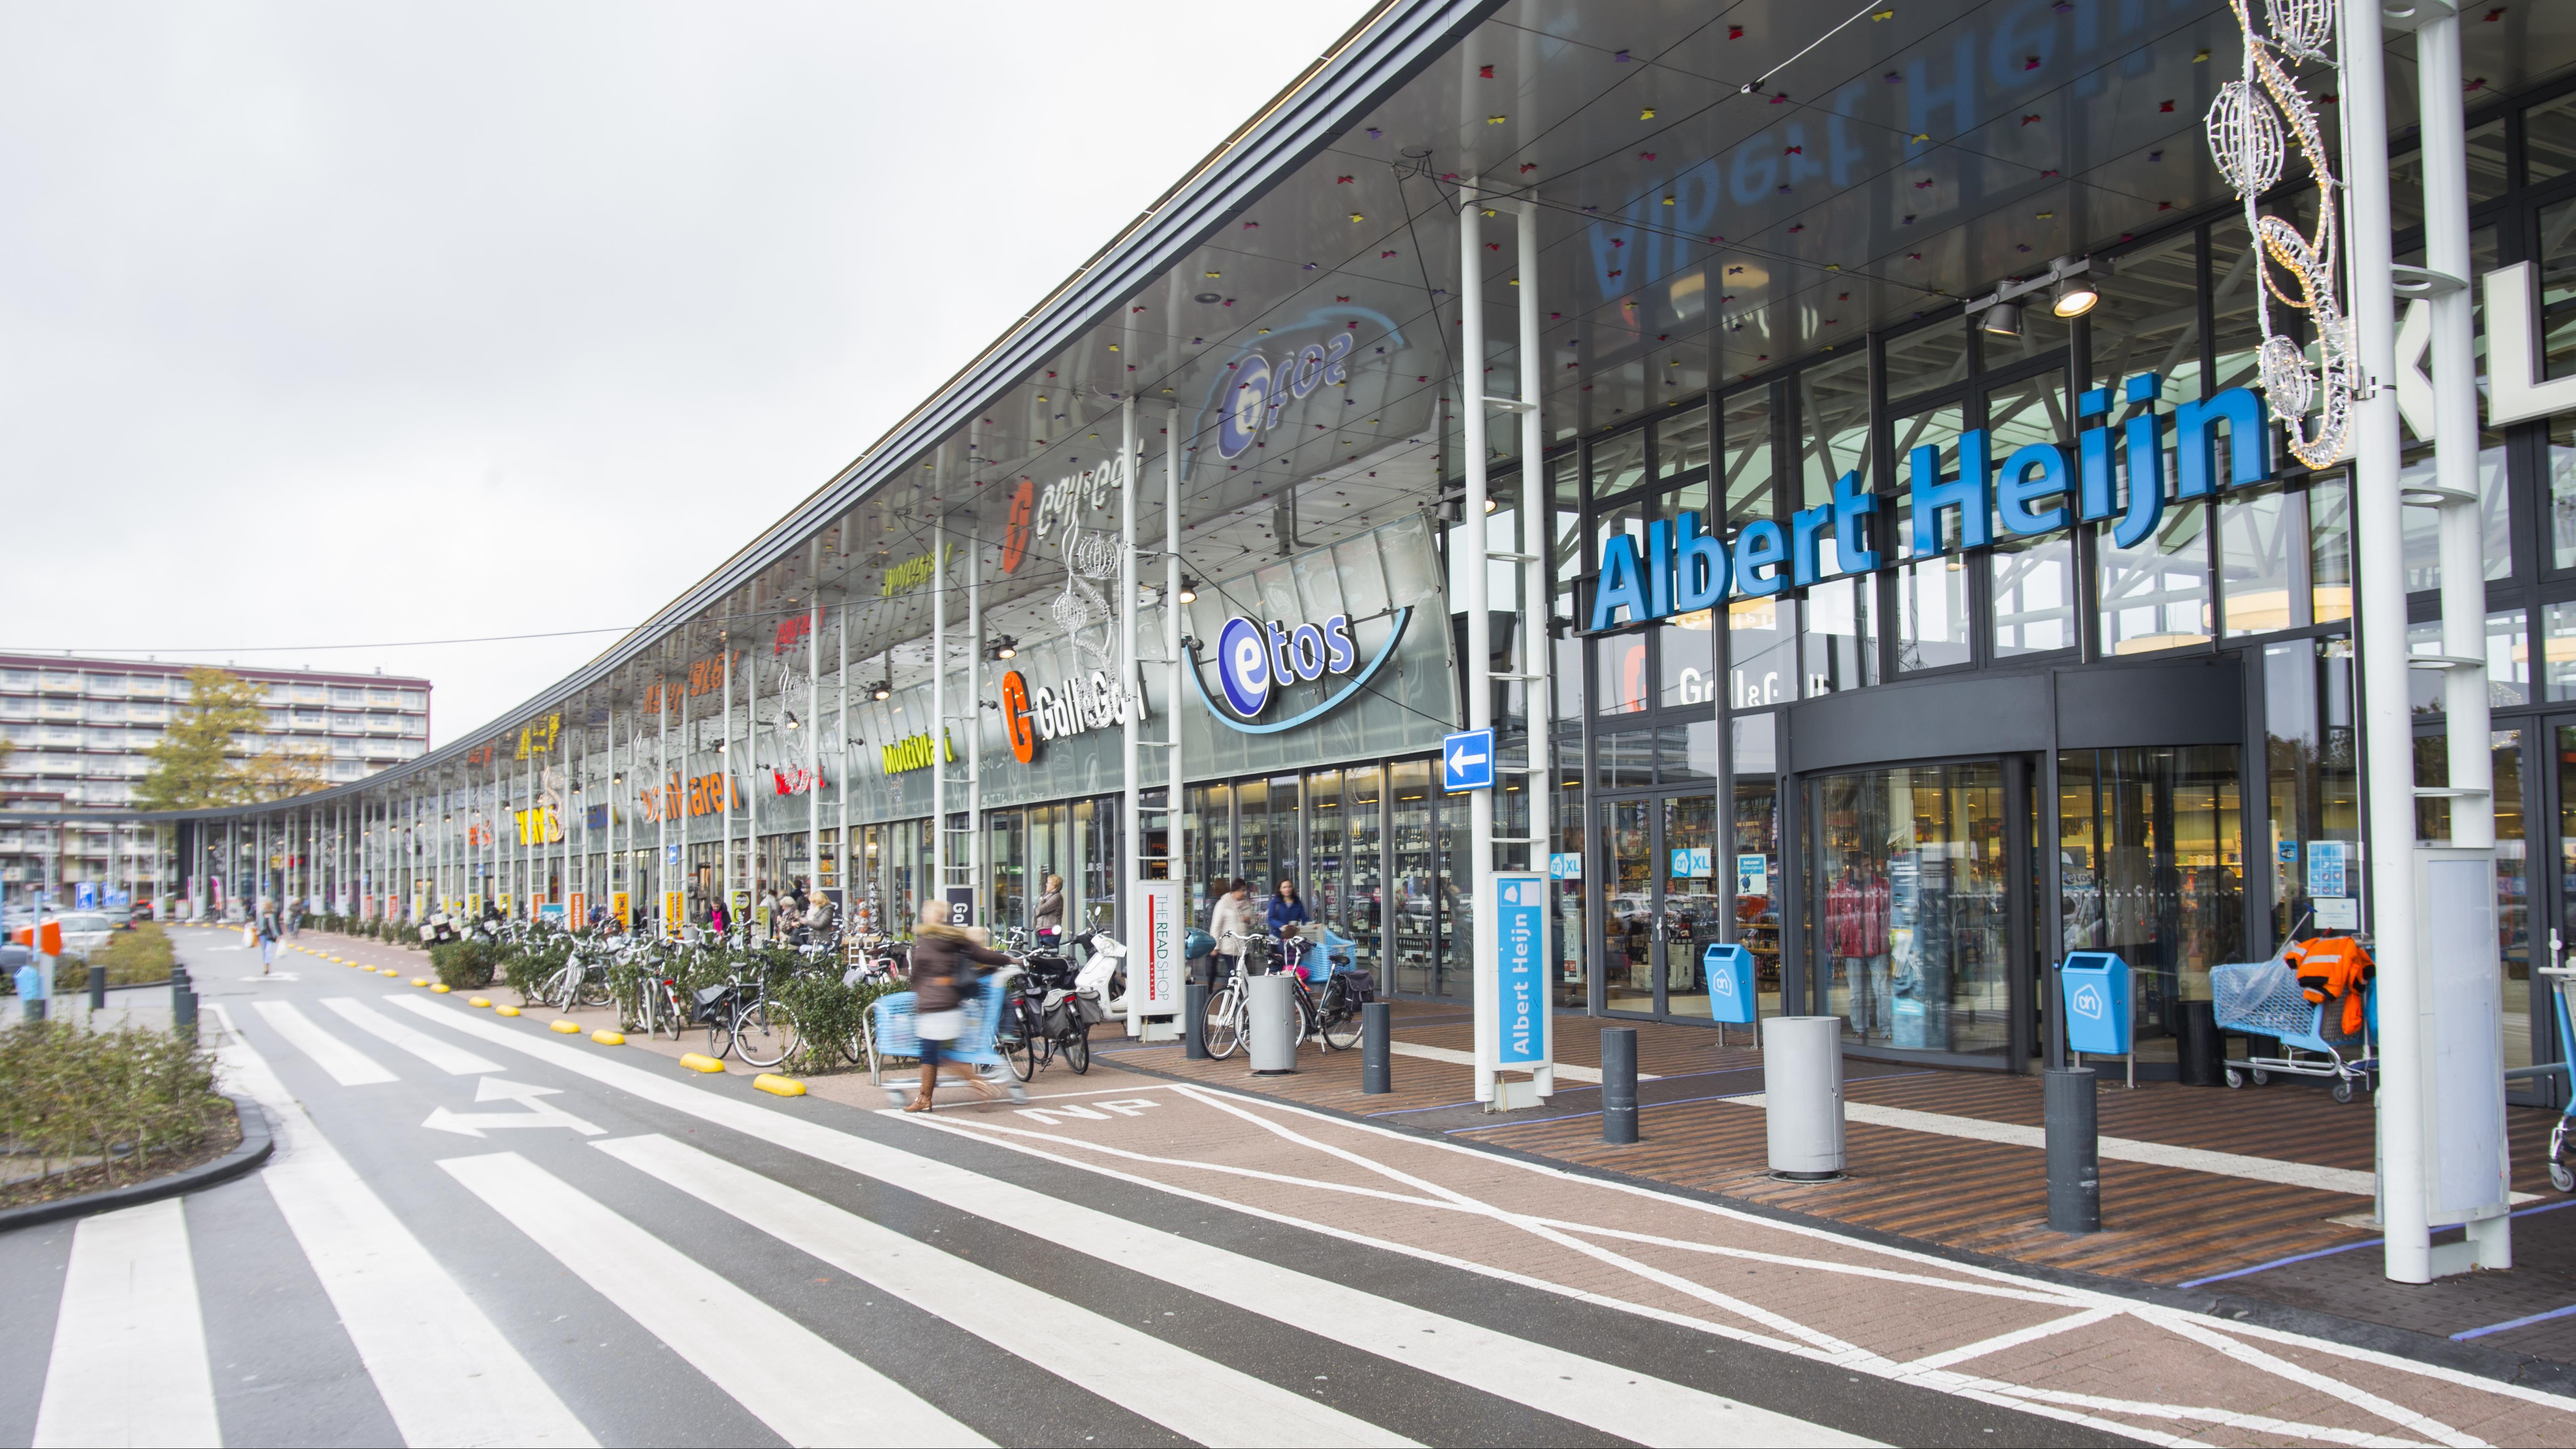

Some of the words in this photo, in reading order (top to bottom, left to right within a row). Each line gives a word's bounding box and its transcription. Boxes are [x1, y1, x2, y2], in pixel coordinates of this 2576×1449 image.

[1591, 469, 1881, 632] Albert
[1910, 372, 2271, 550] Heijn
[1217, 615, 1355, 717] etos
[882, 727, 954, 775] MultiVlai
[1566, 860, 1579, 872] XL
[1693, 856, 1709, 869] XL
[1511, 913, 1531, 973] Heijn
[1513, 982, 1530, 1055] Albert
